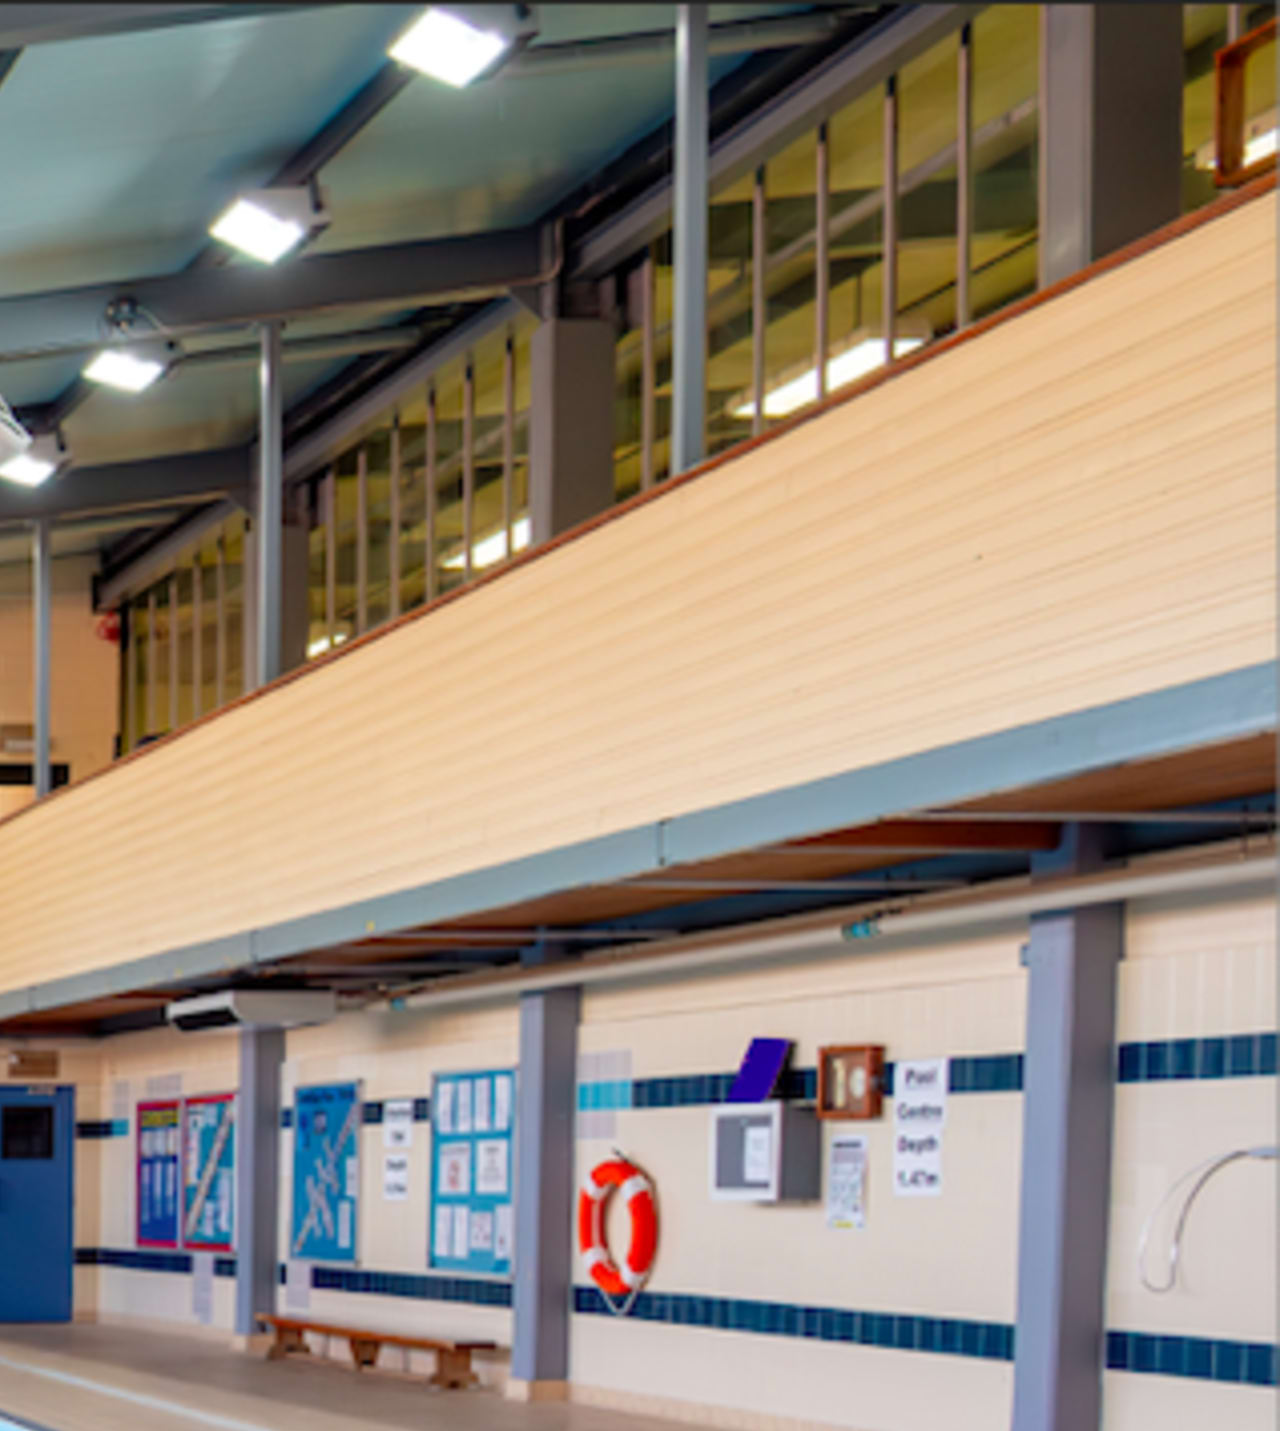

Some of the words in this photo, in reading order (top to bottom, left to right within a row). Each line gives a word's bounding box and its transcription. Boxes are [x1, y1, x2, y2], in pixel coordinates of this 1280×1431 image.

[905, 1067, 938, 1085] Pool
[898, 1102, 943, 1120] Centre
[898, 1135, 939, 1156] Depth
